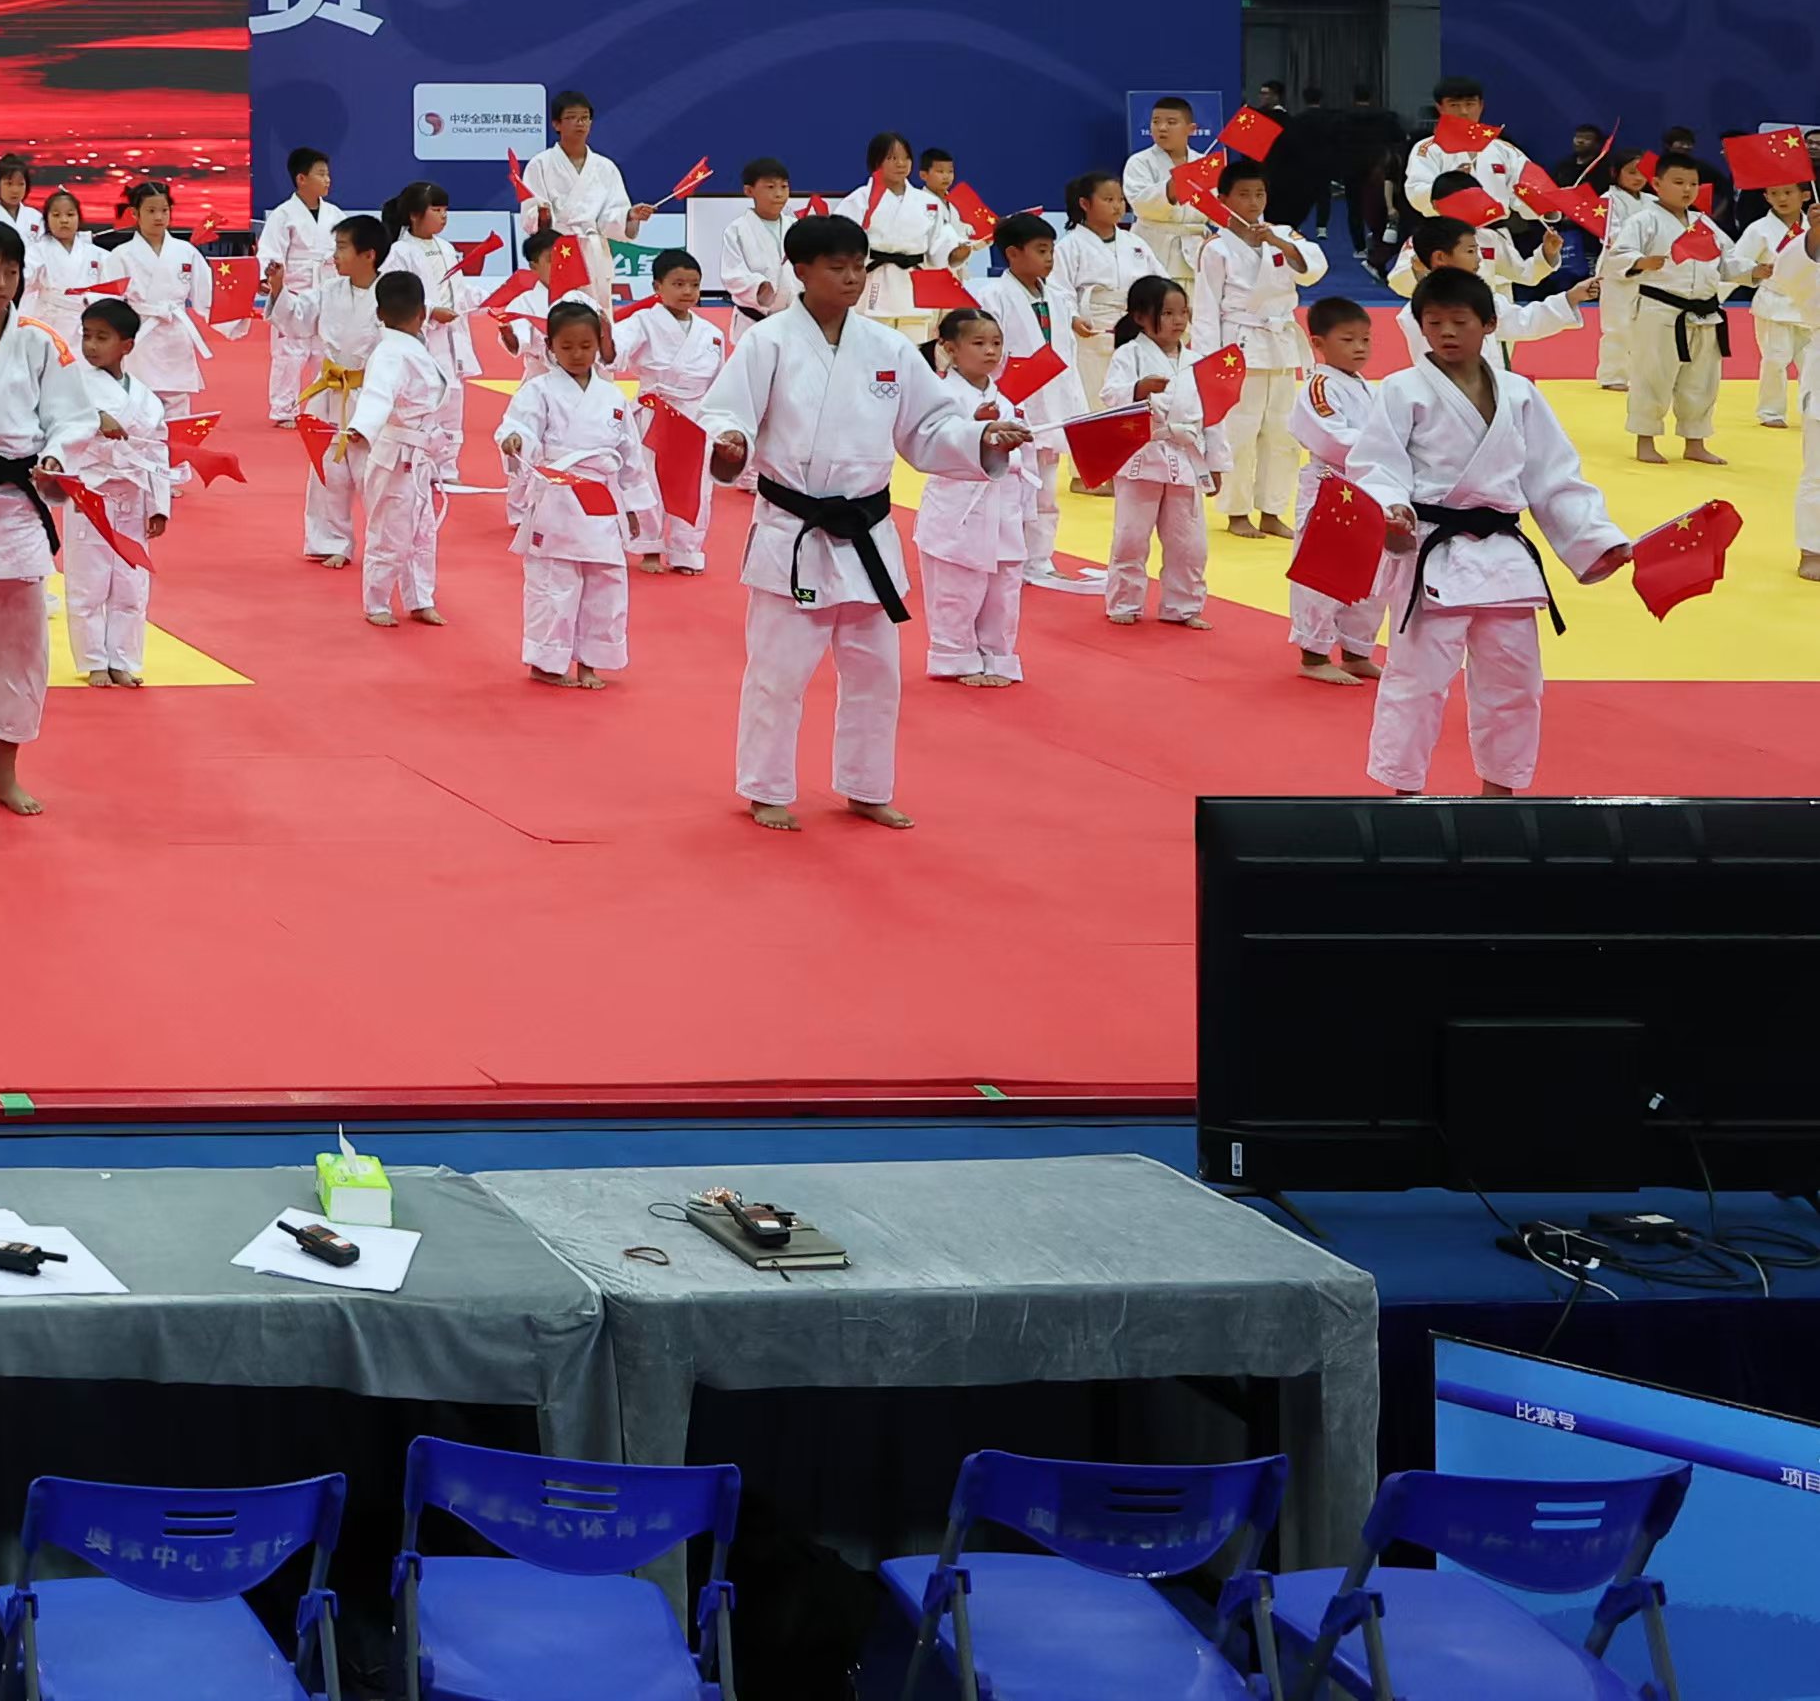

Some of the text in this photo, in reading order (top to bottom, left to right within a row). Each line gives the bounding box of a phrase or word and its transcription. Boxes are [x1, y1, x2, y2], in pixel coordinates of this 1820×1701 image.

[450, 114, 543, 125] 中华全国体育基金会
[1515, 1401, 1577, 1432] 比赛号
[1779, 1466, 1820, 1493] 项目
